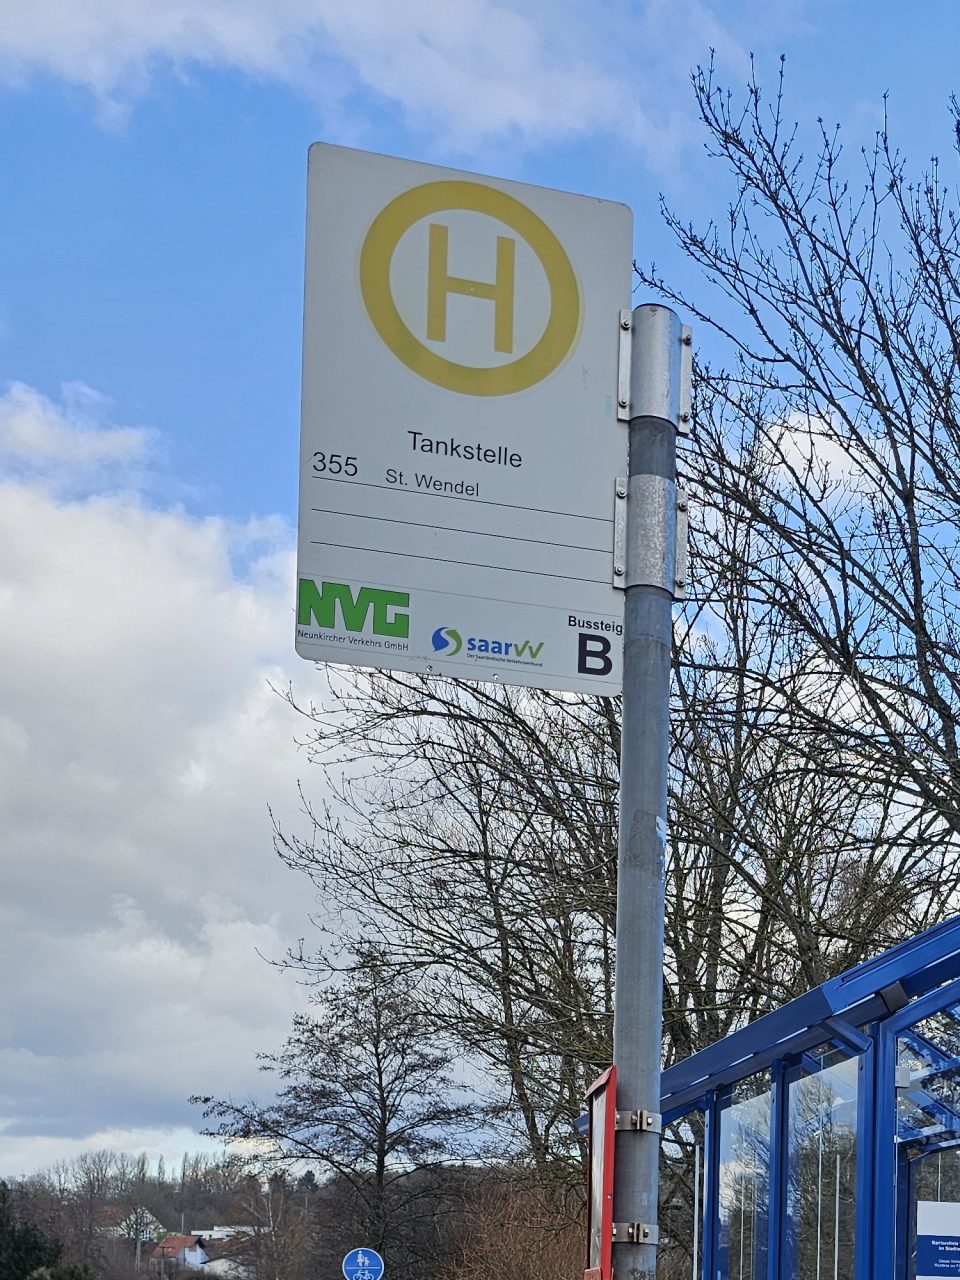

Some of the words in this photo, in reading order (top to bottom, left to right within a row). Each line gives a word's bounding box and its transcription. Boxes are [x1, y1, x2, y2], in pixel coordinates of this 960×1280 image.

[426, 223, 515, 354] H
[312, 451, 358, 477] 355
[407, 430, 523, 468] Tankstelle
[385, 468, 408, 486] St.
[415, 473, 479, 497] Wendel
[298, 578, 410, 639] NVG
[297, 629, 346, 643] Neunkircher
[348, 636, 382, 648] Verkehrs
[384, 640, 409, 651] GmbH
[567, 615, 623, 636] Bussteig
[577, 632, 613, 676] B
